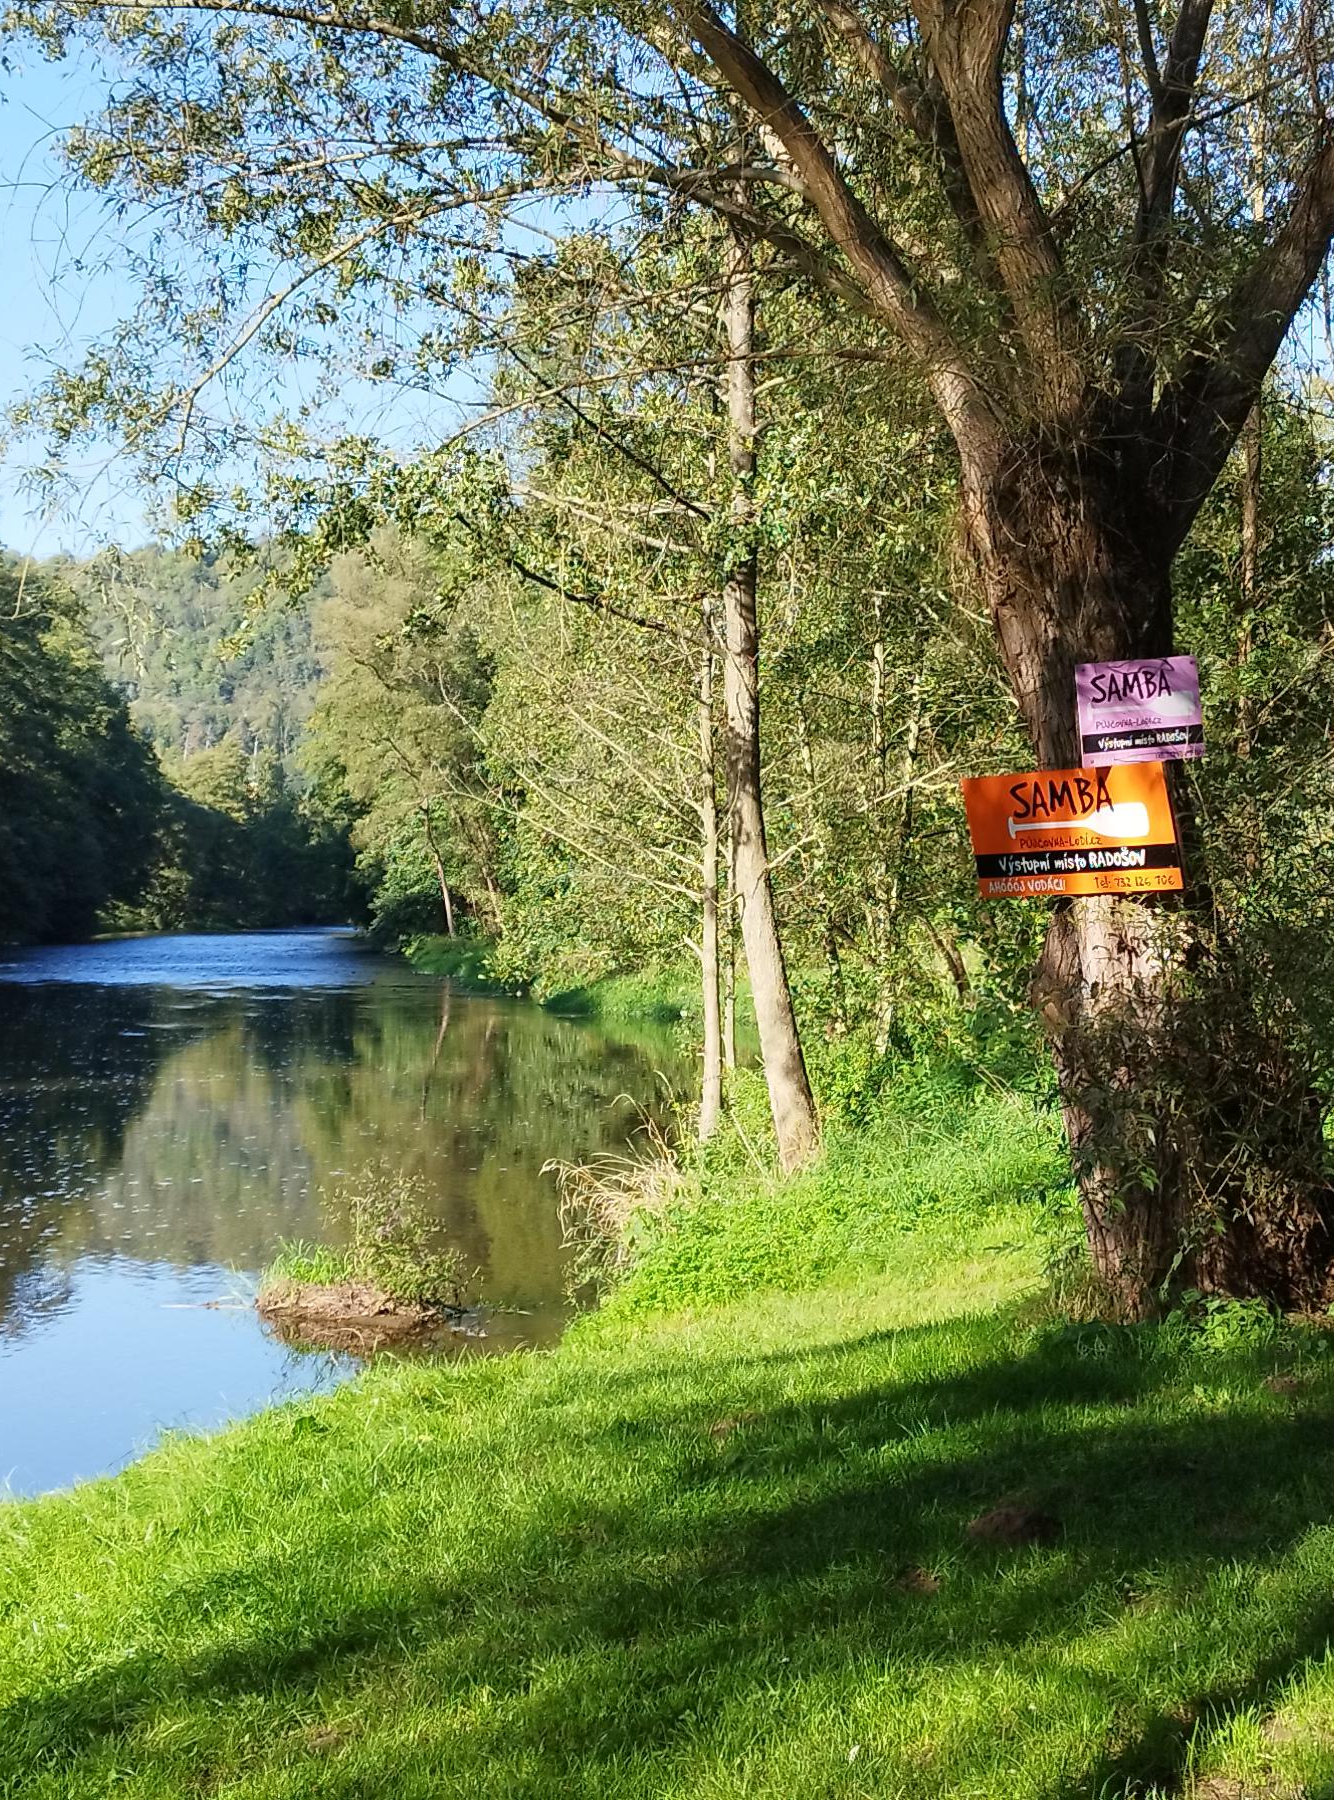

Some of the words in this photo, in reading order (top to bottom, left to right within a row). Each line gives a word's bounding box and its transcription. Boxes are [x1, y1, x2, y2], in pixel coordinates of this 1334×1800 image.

[1090, 670, 1172, 703] SAMBA
[1098, 734, 1133, 752] Výstupní
[1009, 777, 1115, 819] SAMBA
[998, 853, 1051, 876] Výstupní
[1054, 852, 1087, 871] místo
[1088, 846, 1146, 869] RADOŠOV
[989, 877, 1025, 893] AHÓÓÓJ
